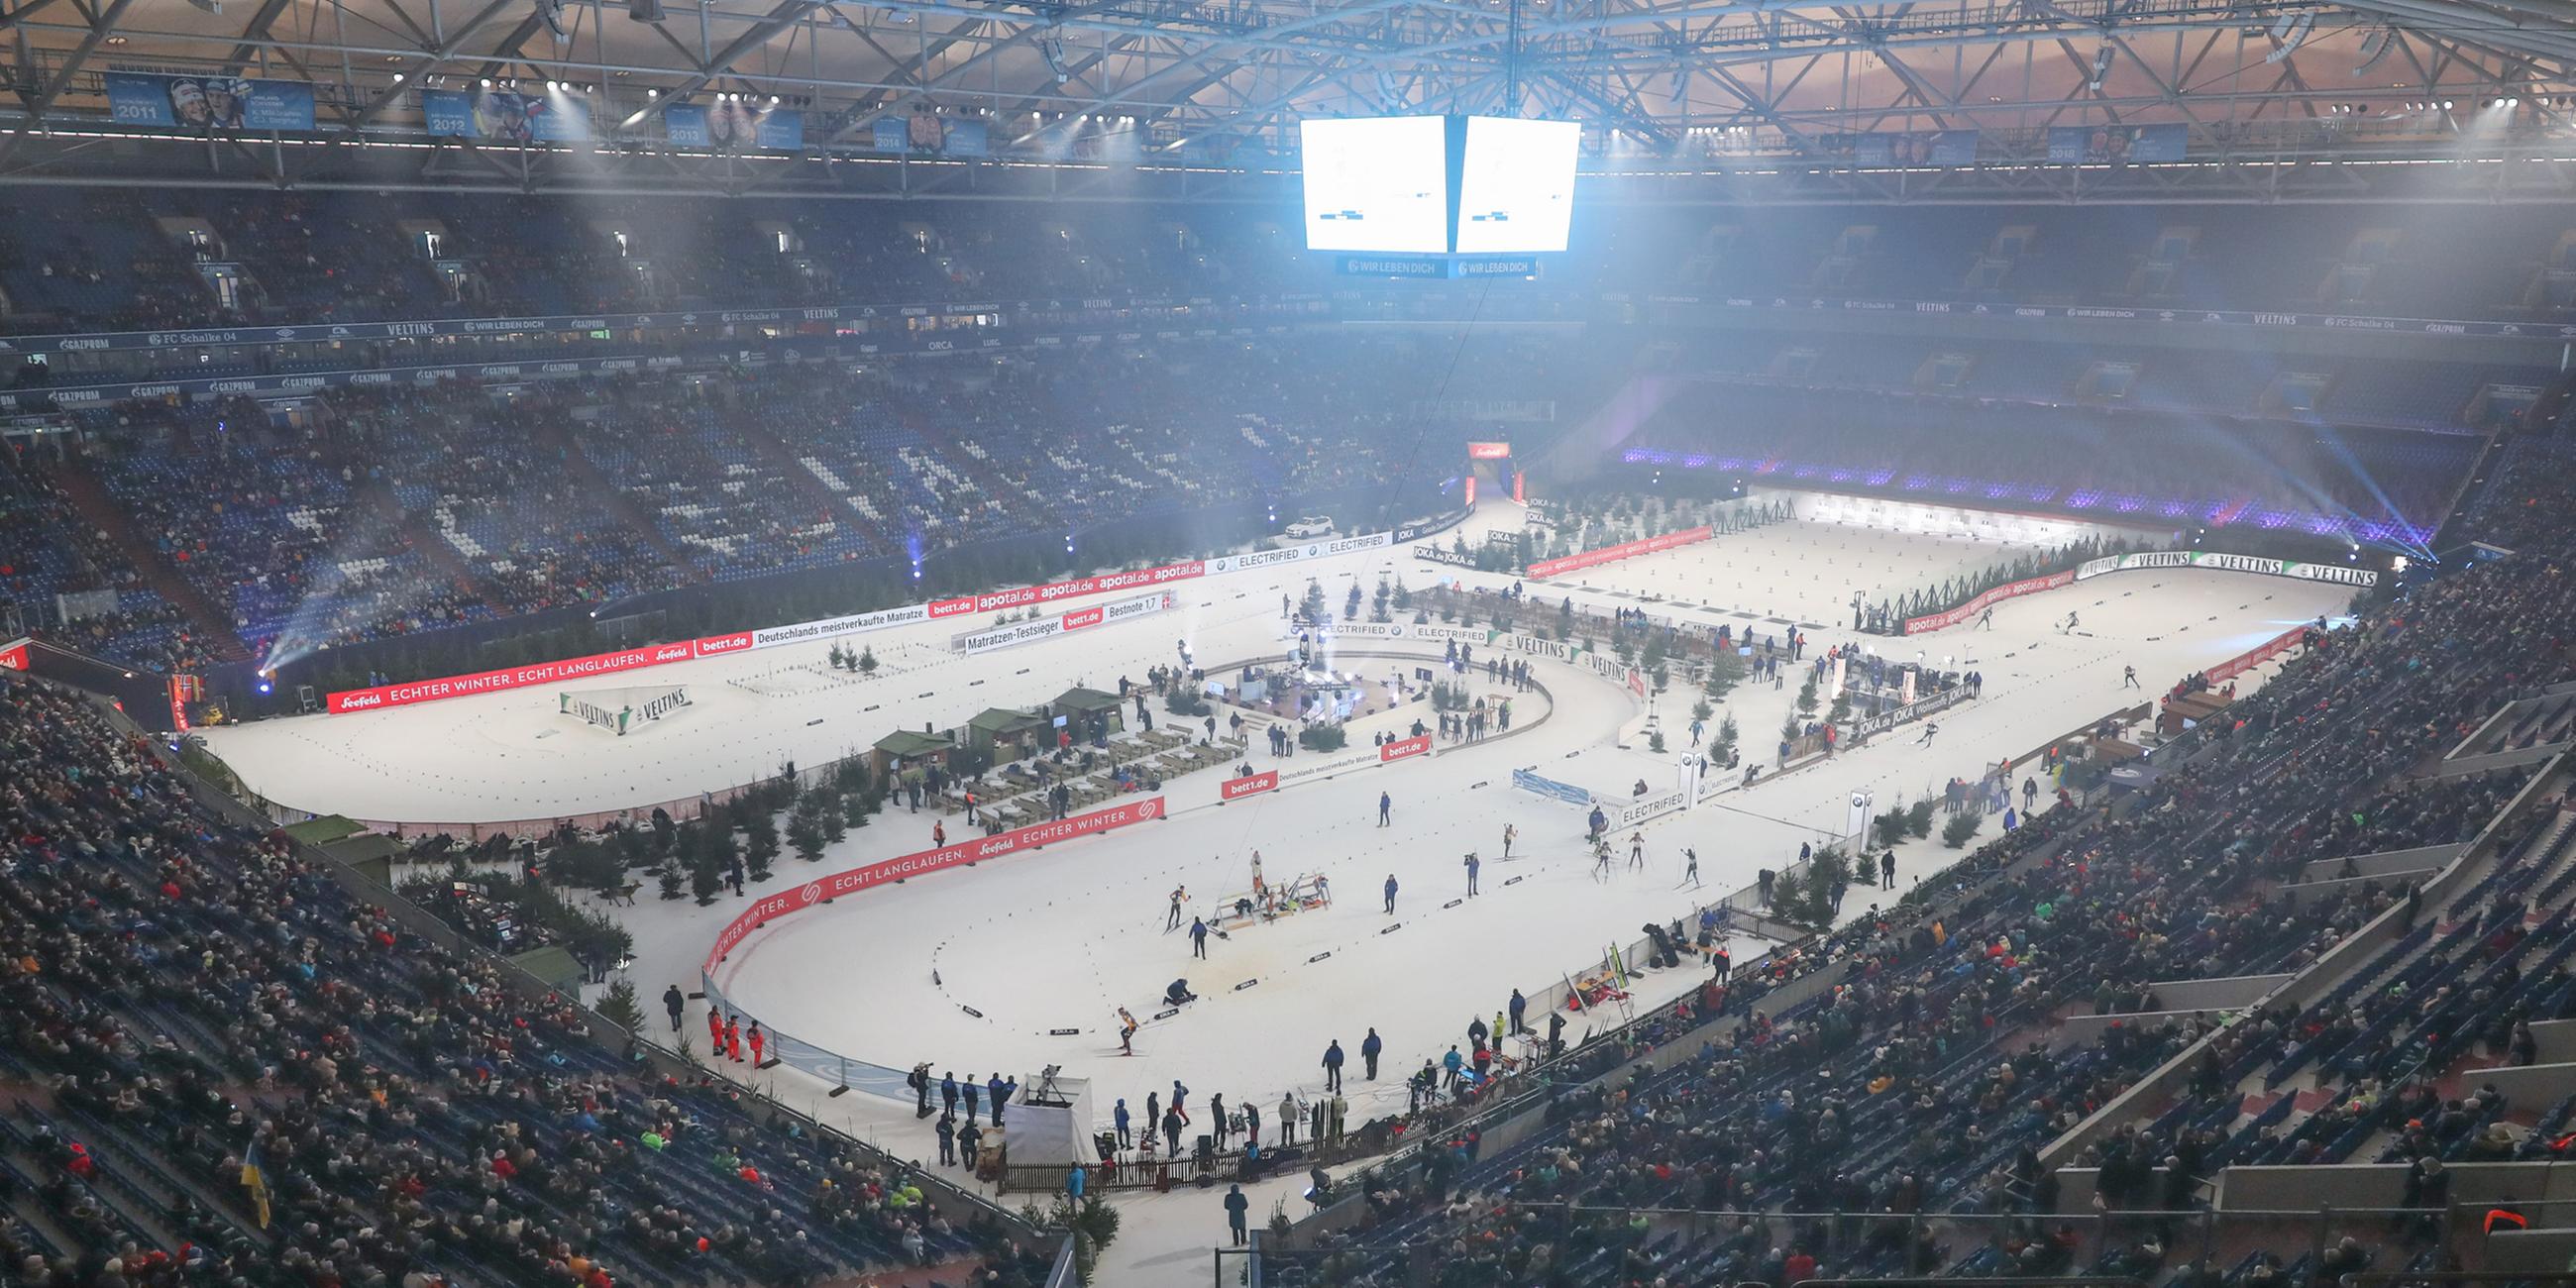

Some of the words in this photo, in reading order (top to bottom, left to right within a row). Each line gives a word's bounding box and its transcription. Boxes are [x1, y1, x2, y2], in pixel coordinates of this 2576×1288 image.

[118, 105, 158, 120] 2011
[433, 118, 466, 131] 2012
[671, 129, 698, 140] 2013
[876, 137, 900, 148] 2014
[2049, 149, 2076, 159] 2018
[1359, 262, 1378, 271] WIR
[1379, 262, 1409, 272] LEBEN
[1411, 263, 1435, 274] DICH
[1468, 263, 1484, 273] WIR
[1485, 263, 1508, 273] LEBEN
[1509, 261, 1528, 272] DICH
[1083, 299, 1112, 309] VELTINS
[1916, 302, 1950, 313] VELTINS
[804, 308, 839, 320] VELTINS
[2254, 313, 2297, 326] VELTINS
[386, 322, 435, 336] VELTINS
[476, 322, 492, 331] WIR
[493, 321, 521, 331] LEBEN
[522, 320, 545, 330] DICH
[69, 339, 110, 350] GAZPROM
[163, 333, 177, 344] FC
[180, 332, 221, 344] Schalke
[224, 332, 237, 343] 04
[928, 341, 953, 351] ORCA
[424, 369, 457, 380] GAZPROM
[488, 366, 520, 376] GAZPROM
[289, 376, 326, 388] GAZPROM
[358, 373, 391, 384] GAZPROM
[141, 385, 180, 397] GAZPROM
[217, 380, 256, 392] GAZPROM
[57, 390, 100, 402] GAZPROM
[1398, 529, 1415, 541] JOKA
[1330, 535, 1384, 553] ELECTRIFIED
[1238, 549, 1299, 568] ELECTRIFIED
[1414, 546, 1444, 561] JOKA.de
[1444, 552, 1476, 567] JOKA.de
[2139, 552, 2188, 566] VELTINS
[2219, 556, 2280, 573] VELTINS
[2312, 566, 2374, 586] VELTINS
[980, 590, 1034, 609] apotal.de
[1041, 580, 1094, 599] apotal.de
[1099, 571, 1150, 590] apotal.de
[1154, 563, 1202, 582] apotal.de
[933, 601, 970, 615] bett1.de
[1109, 600, 1144, 617] Bestnote
[1145, 597, 1156, 612] 1,7
[1067, 610, 1099, 627] bett1.de
[758, 626, 818, 644] Deutschlands
[820, 614, 885, 633] meistverkaufte
[887, 608, 923, 624] Matratze
[967, 619, 1059, 650] Matratzen-Testsieger
[1418, 628, 1485, 641] ELECTRIFIED
[702, 636, 747, 652] bett1.de
[1516, 635, 1564, 659] VELTINS
[656, 647, 688, 662] Seefeld
[1591, 655, 1626, 681] VELTINS
[390, 684, 450, 701] ECHTER
[454, 675, 515, 692] WINTER.
[518, 669, 554, 683] ECHT
[558, 653, 648, 677] LANGLAUFEN.
[341, 695, 381, 709] Seefeld
[643, 689, 686, 719] VELTINS
[579, 700, 613, 728] VELTINS
[1859, 718, 1890, 739] JOKA.de
[1892, 705, 1914, 727] JOKA
[1388, 741, 1421, 758] bett1.de
[1279, 768, 1315, 783] Deutschlands
[1231, 778, 1268, 795] bett1.de
[1623, 793, 1684, 822] ELECTRIFIED
[1023, 823, 1072, 843] ECHTER
[1077, 812, 1129, 832] WINTER.
[979, 839, 1014, 856] Seefeld
[744, 899, 790, 926] WINTER.
[835, 872, 872, 891] ECHT
[876, 849, 966, 880] LANGLAUFEN.
